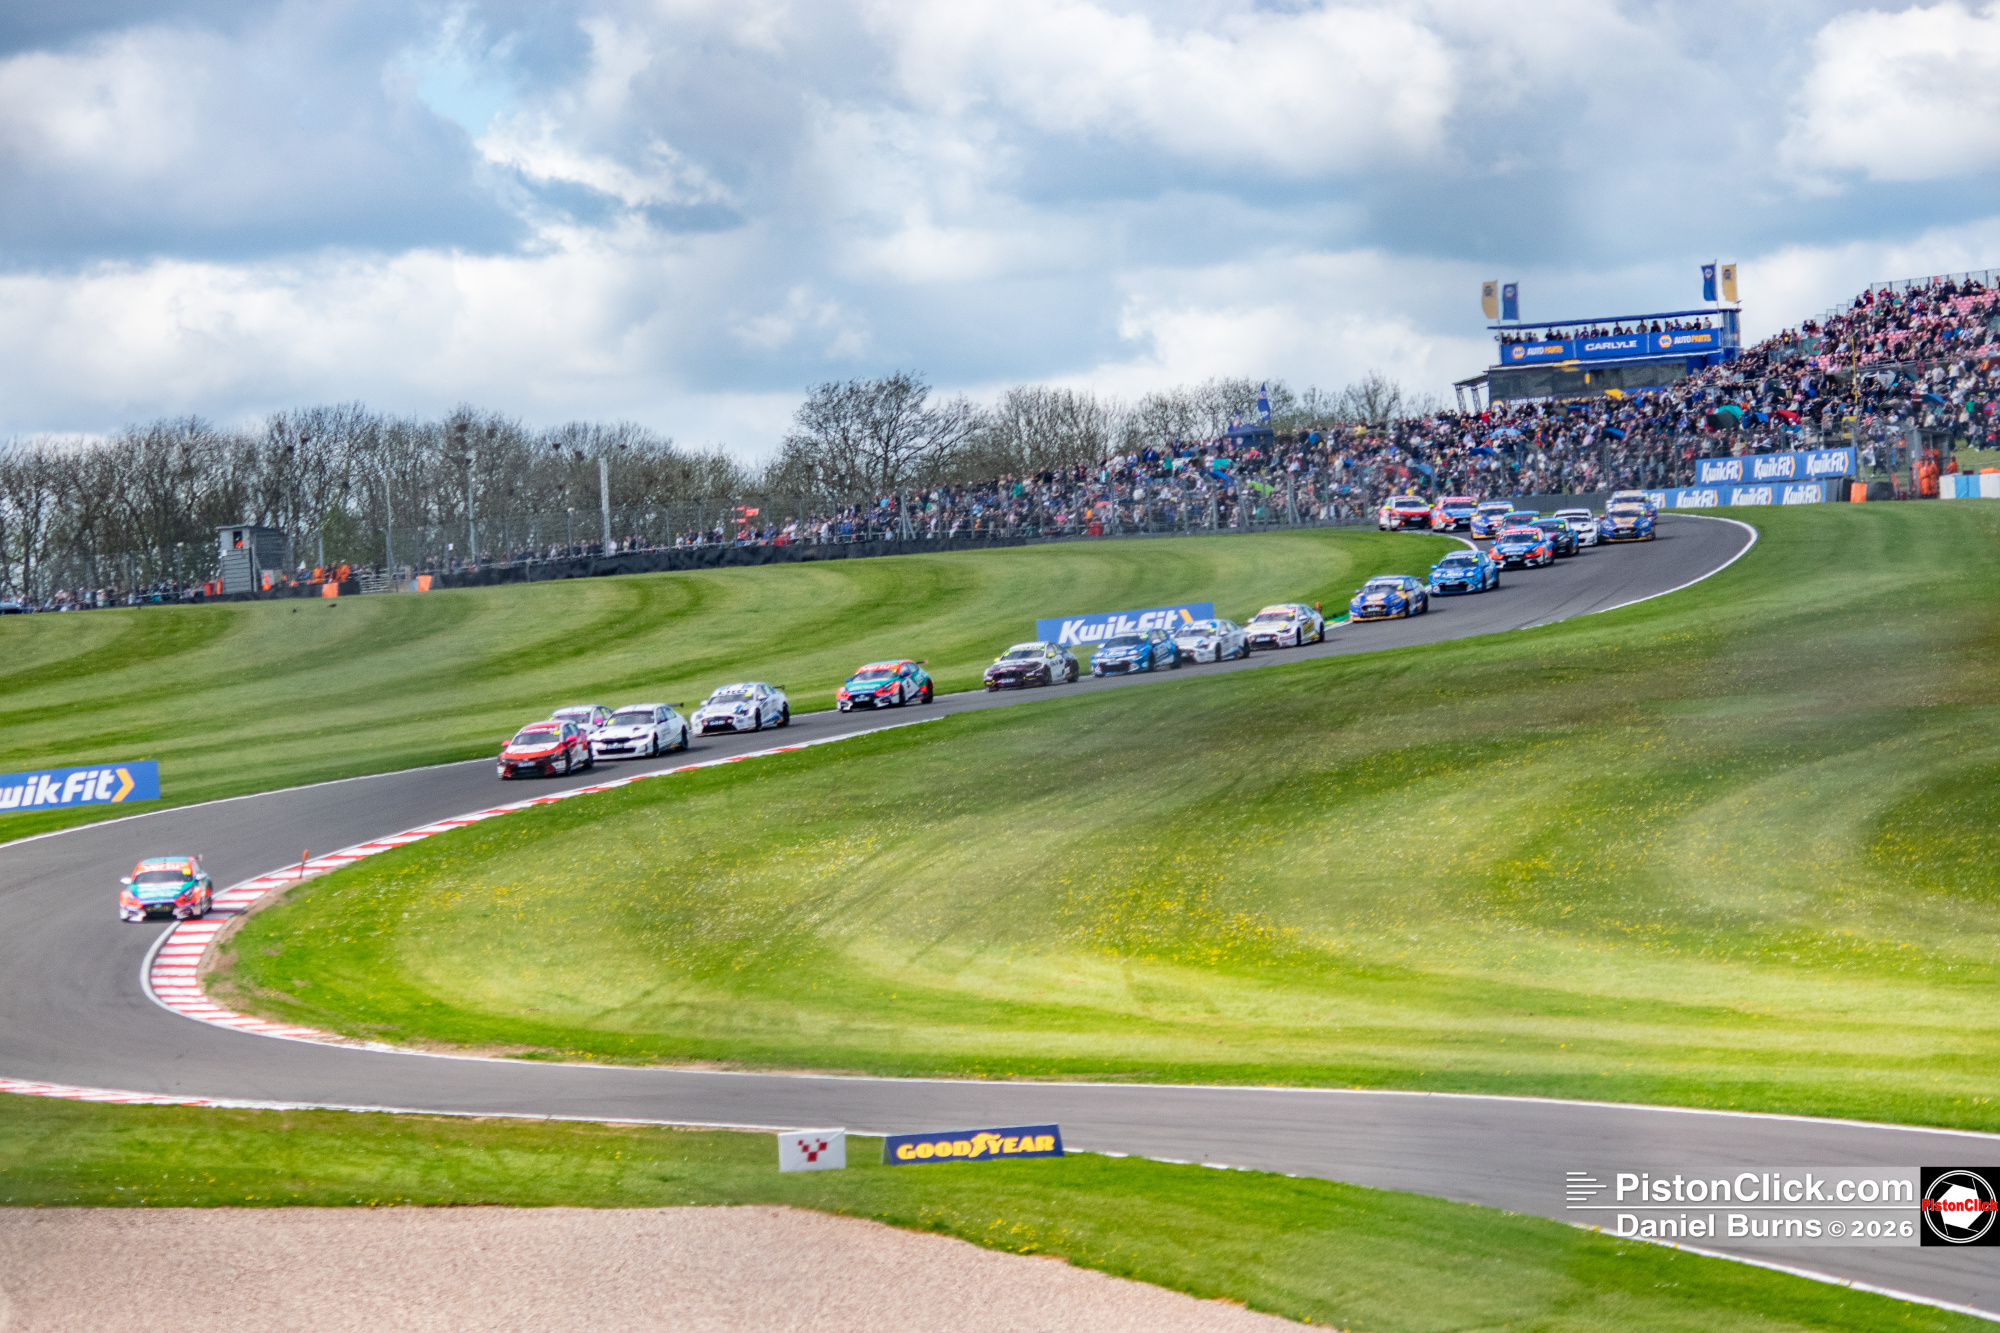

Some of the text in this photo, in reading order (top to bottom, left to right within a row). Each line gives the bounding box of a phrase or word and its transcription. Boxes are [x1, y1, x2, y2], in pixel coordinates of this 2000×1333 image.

[1585, 340, 1637, 352] CARLYLE
[1701, 461, 1739, 484] KwikFit
[1754, 457, 1791, 480] KwikFit
[1806, 453, 1845, 476] KwikFit
[896, 1134, 1055, 1160] GOODYEAR
